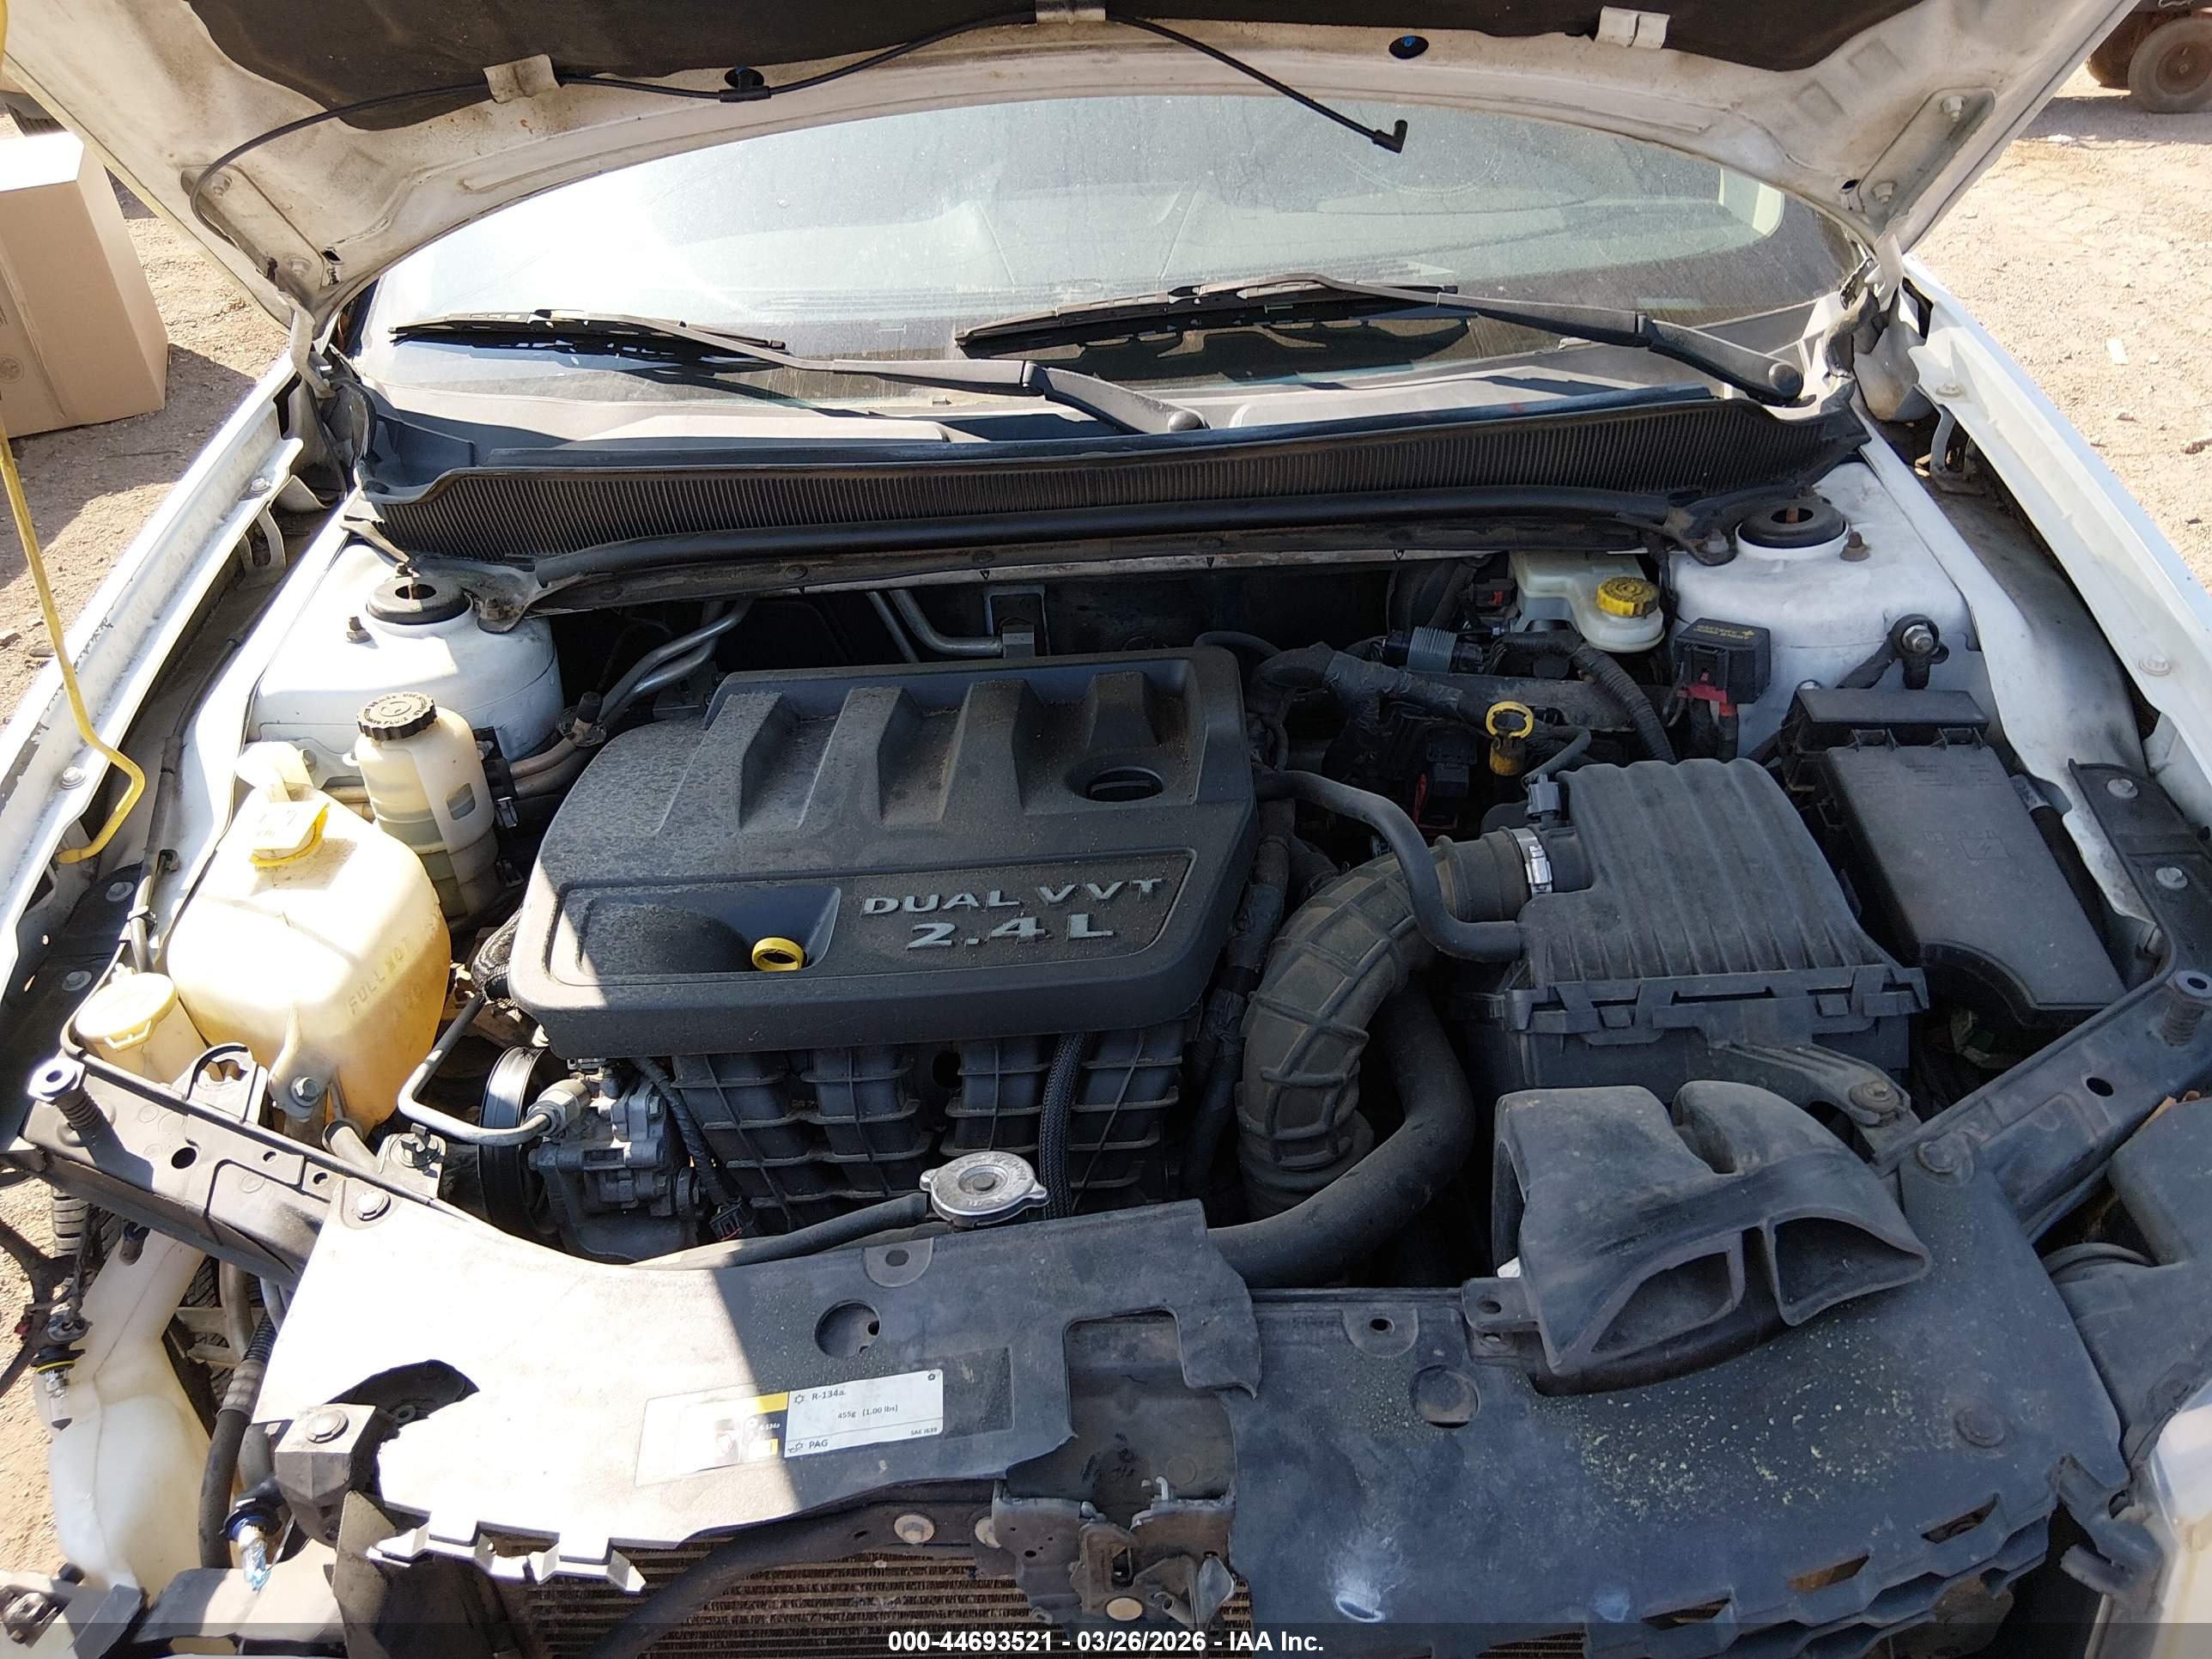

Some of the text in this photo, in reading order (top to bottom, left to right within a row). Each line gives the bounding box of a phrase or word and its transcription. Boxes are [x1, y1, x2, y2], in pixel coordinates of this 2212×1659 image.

[861, 878, 1163, 916] DUAL VVT
[349, 970, 386, 1014] FULL
[811, 1389, 846, 1401] R-134a
[809, 1438, 829, 1449] PAG
